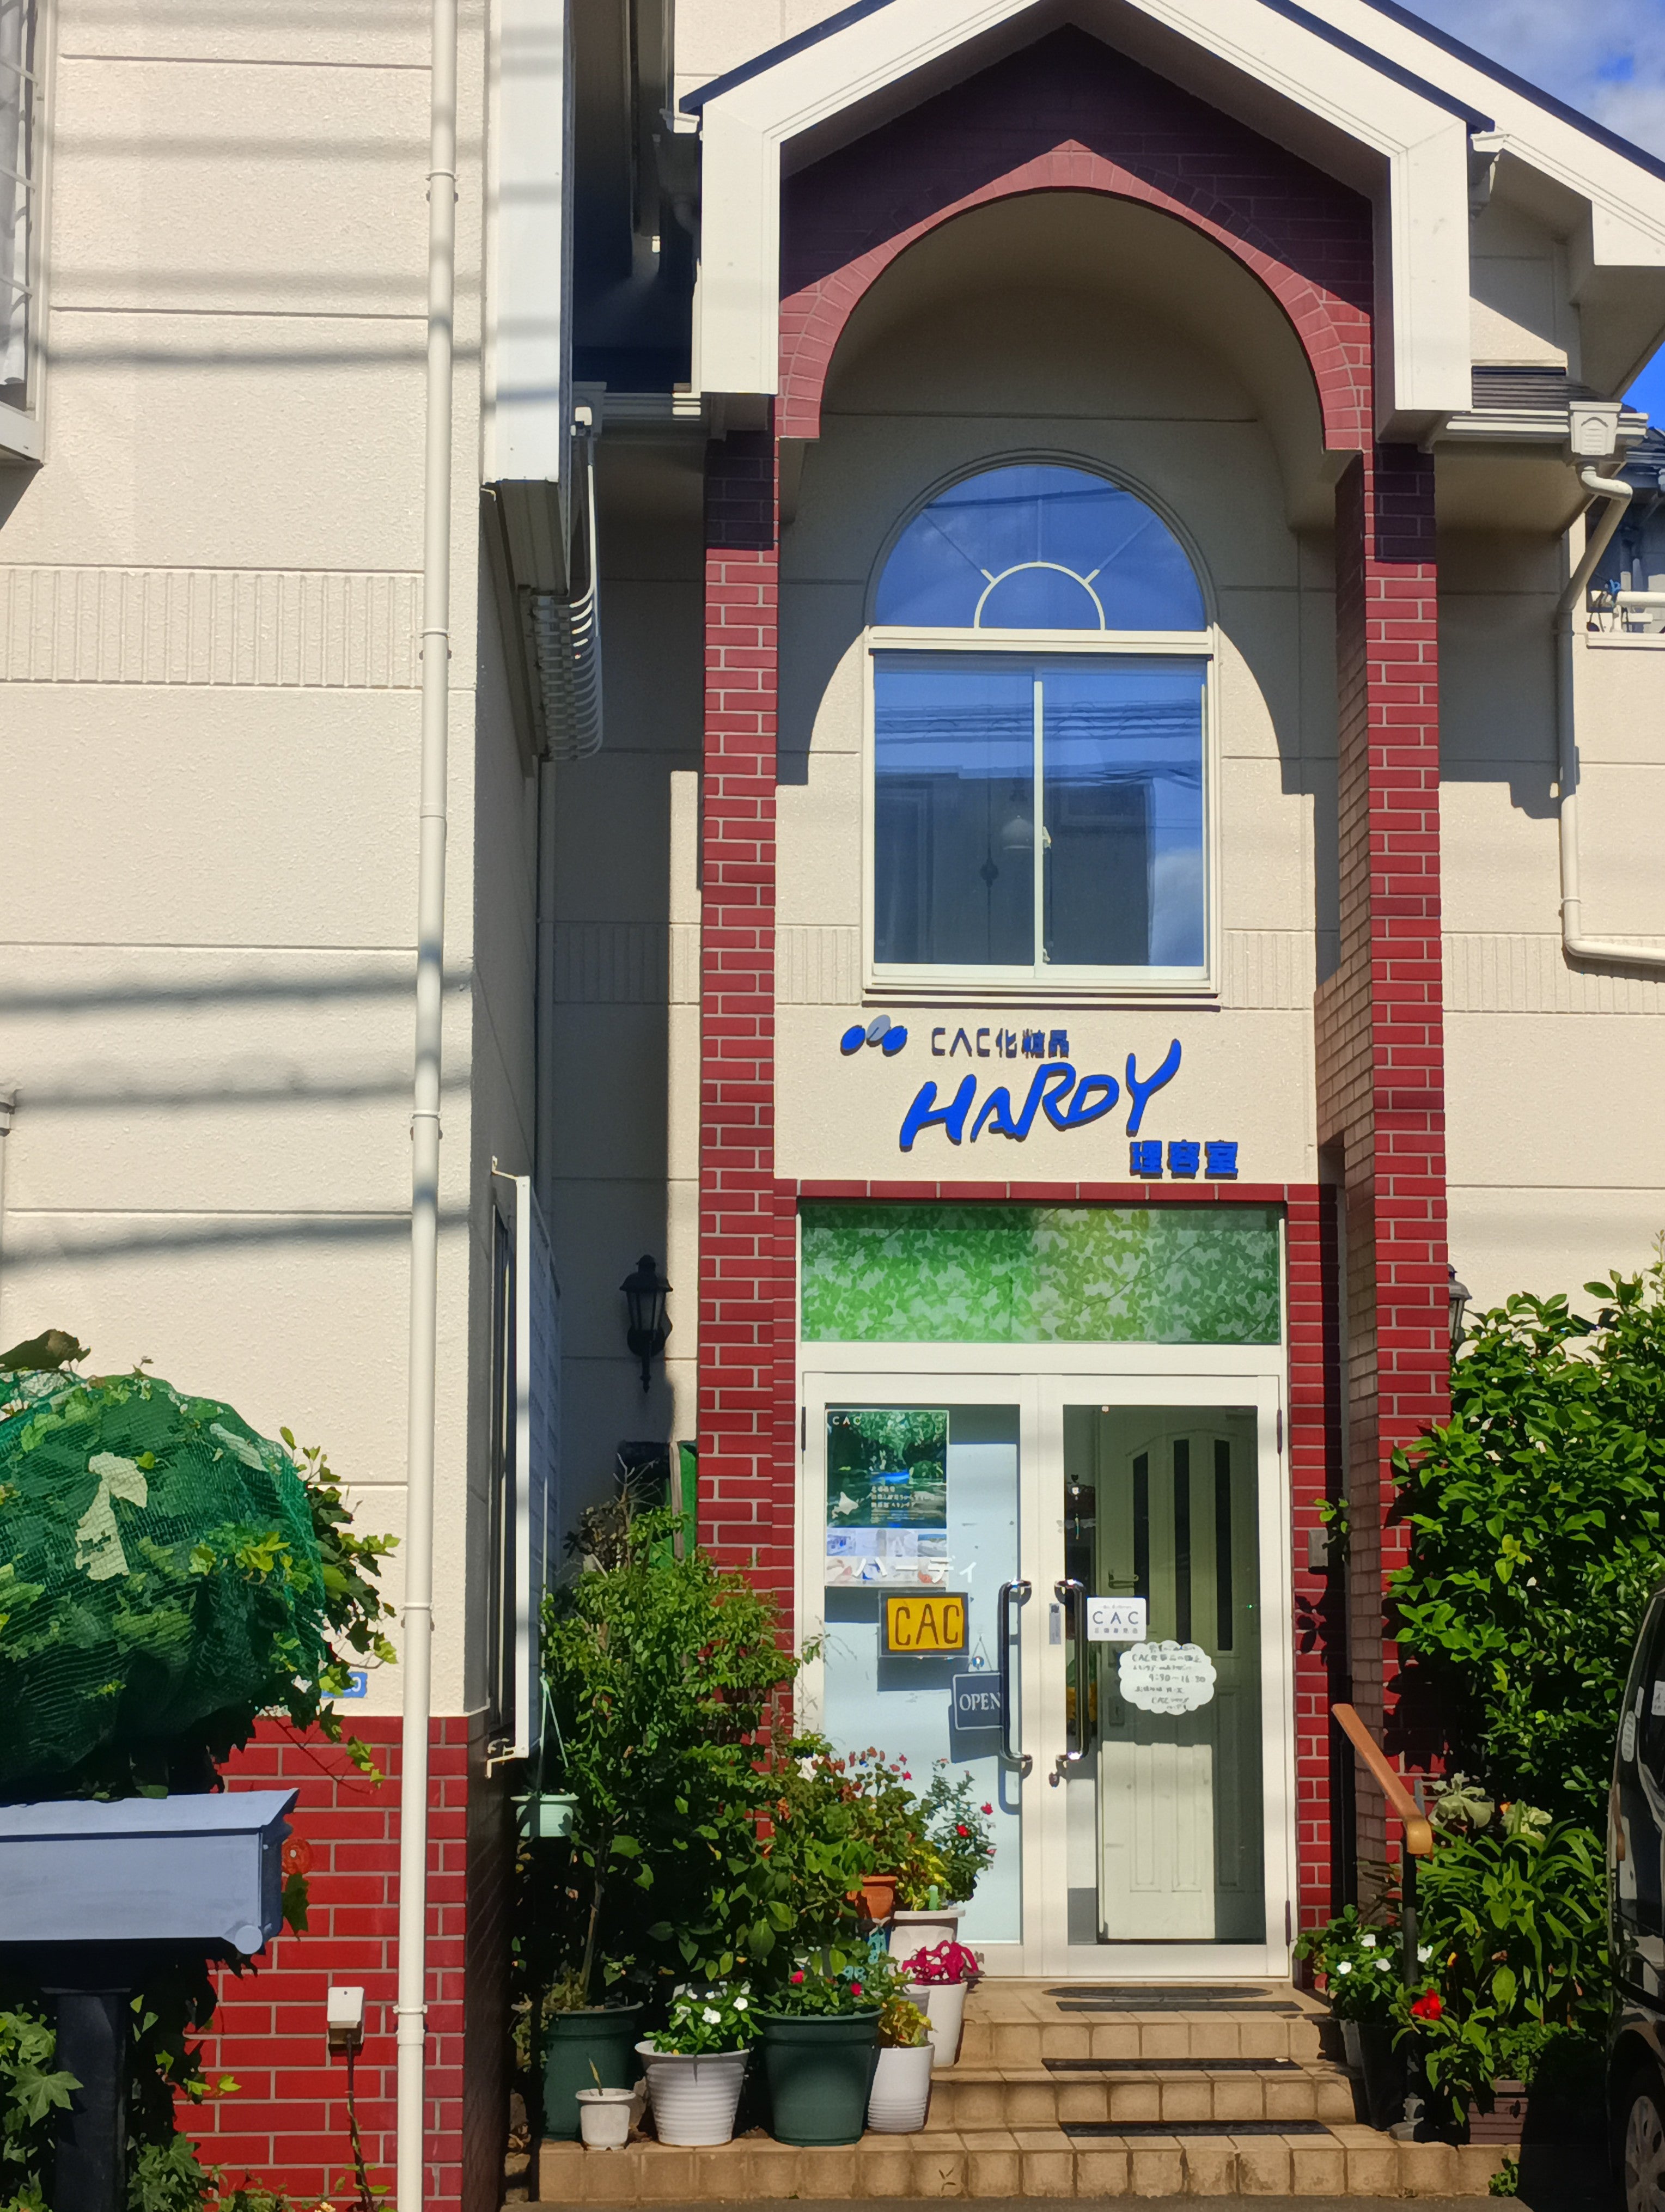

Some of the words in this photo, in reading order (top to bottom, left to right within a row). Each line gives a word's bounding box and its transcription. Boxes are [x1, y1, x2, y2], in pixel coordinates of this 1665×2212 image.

[899, 1039, 1182, 1152] HARDY
[1130, 1139, 1238, 1179] 理容室
[852, 1555, 977, 1583] ハーディ
[894, 1603, 960, 1646] CAC
[1092, 1611, 1139, 1624] CAC
[959, 1691, 1001, 1711] OPEN
